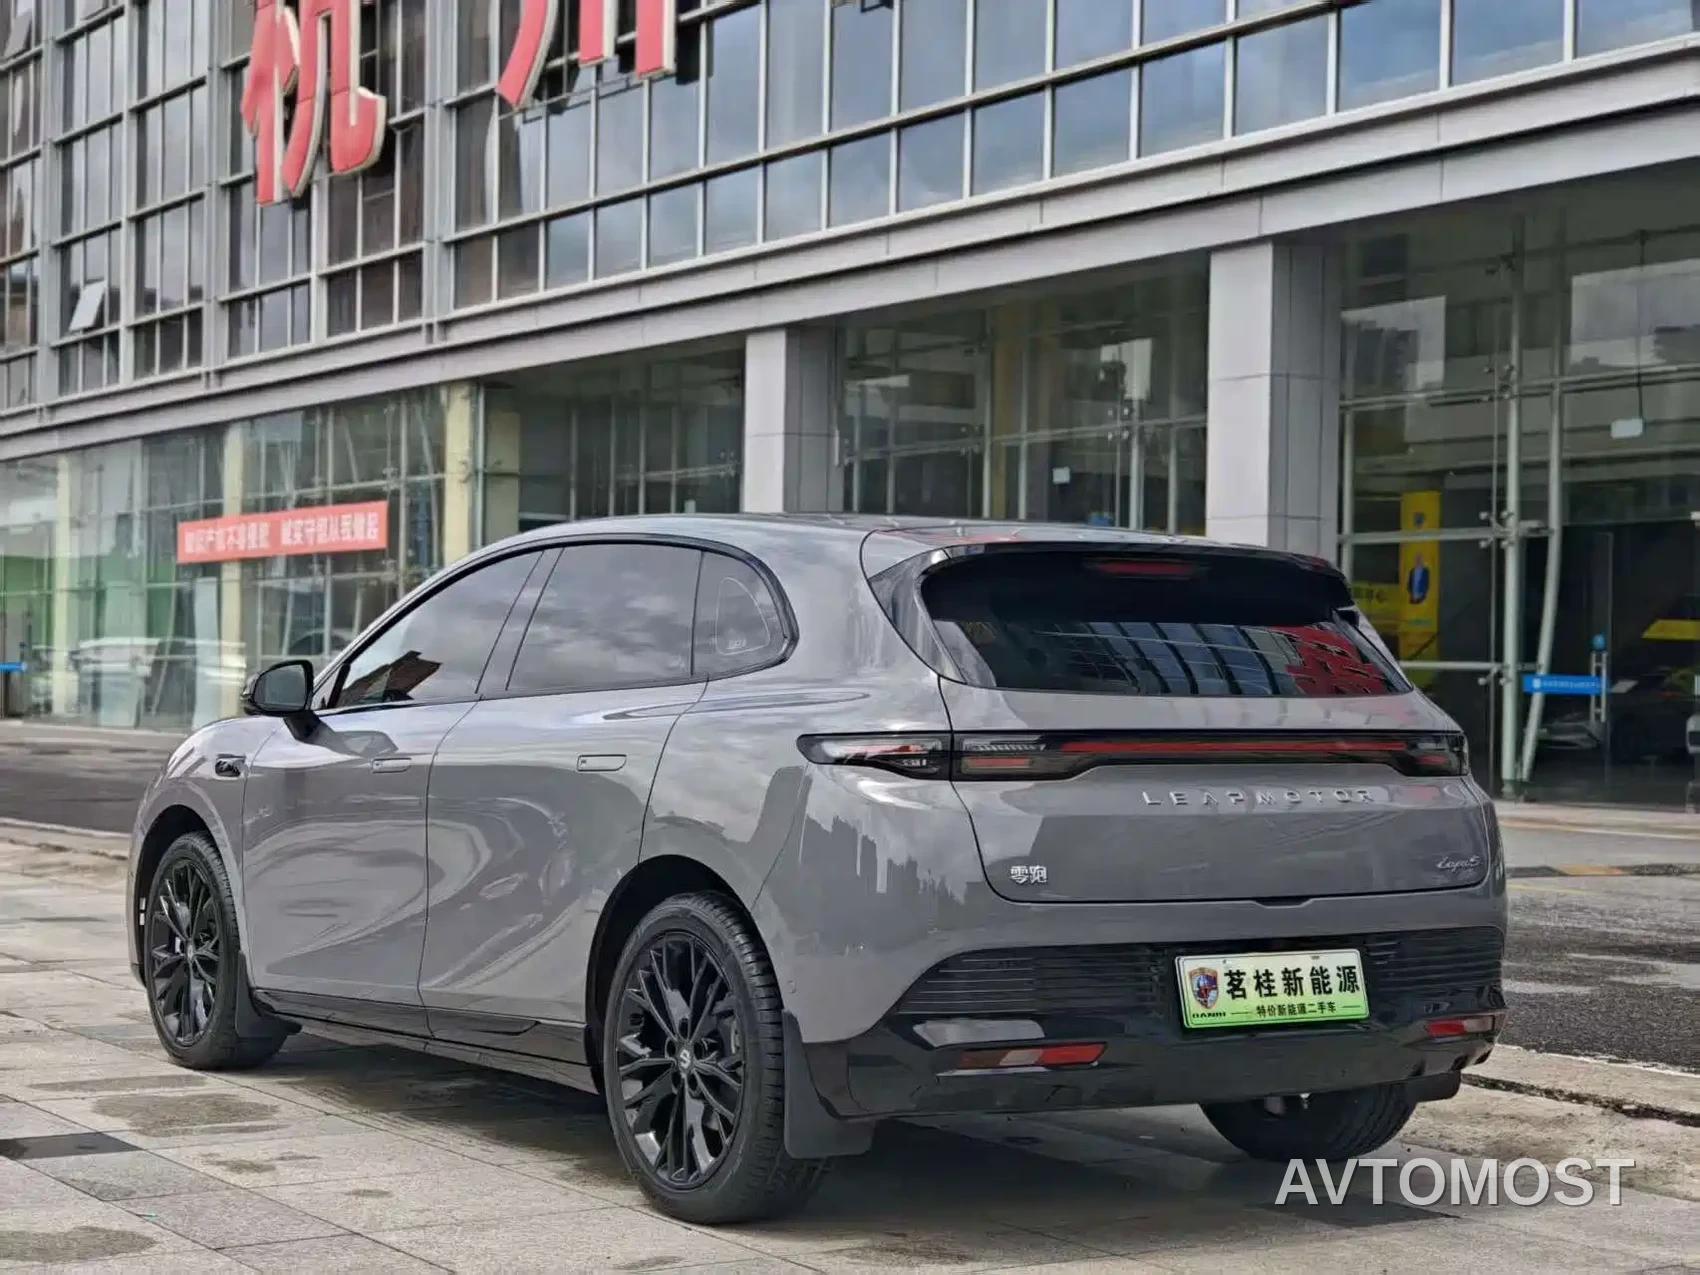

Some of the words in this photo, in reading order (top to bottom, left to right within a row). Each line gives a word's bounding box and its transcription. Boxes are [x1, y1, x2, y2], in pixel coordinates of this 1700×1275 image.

[1142, 789, 1375, 806] LEAPMOTOR
[1010, 864, 1047, 884] 零跑
[1224, 965, 1360, 1000] 茗桂新能源
[1256, 1001, 1337, 1018] 特价新能源二手车
